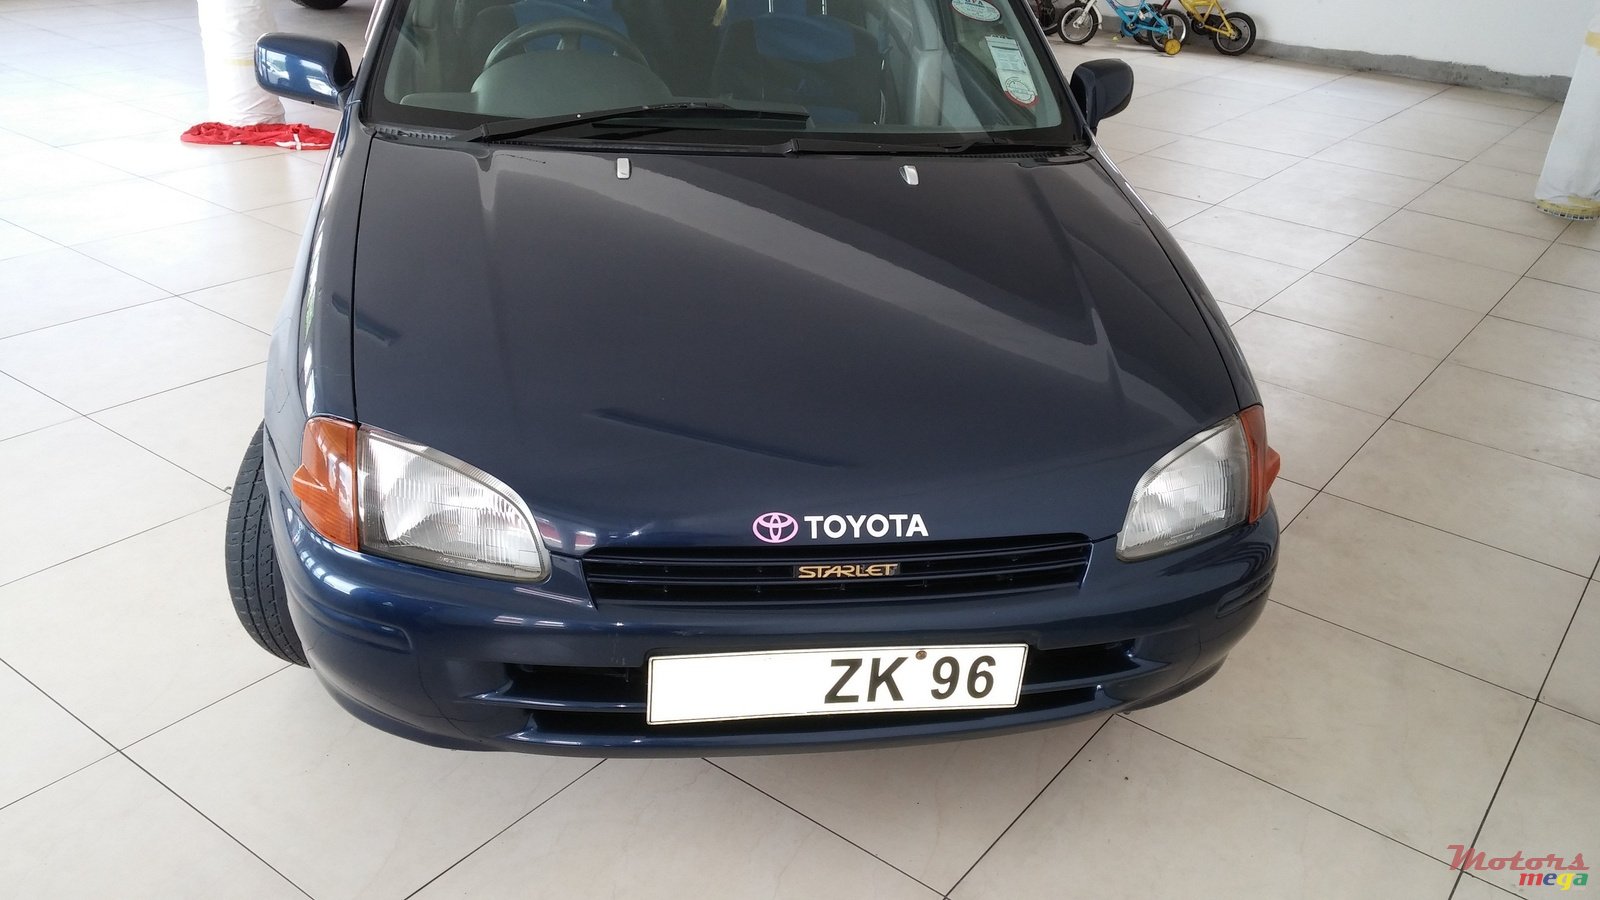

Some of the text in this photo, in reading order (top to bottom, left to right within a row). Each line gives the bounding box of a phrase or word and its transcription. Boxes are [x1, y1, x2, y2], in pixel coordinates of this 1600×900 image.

[804, 513, 929, 539] TOYOTA
[798, 563, 898, 579] STARLET
[824, 655, 996, 705] ZK 96
